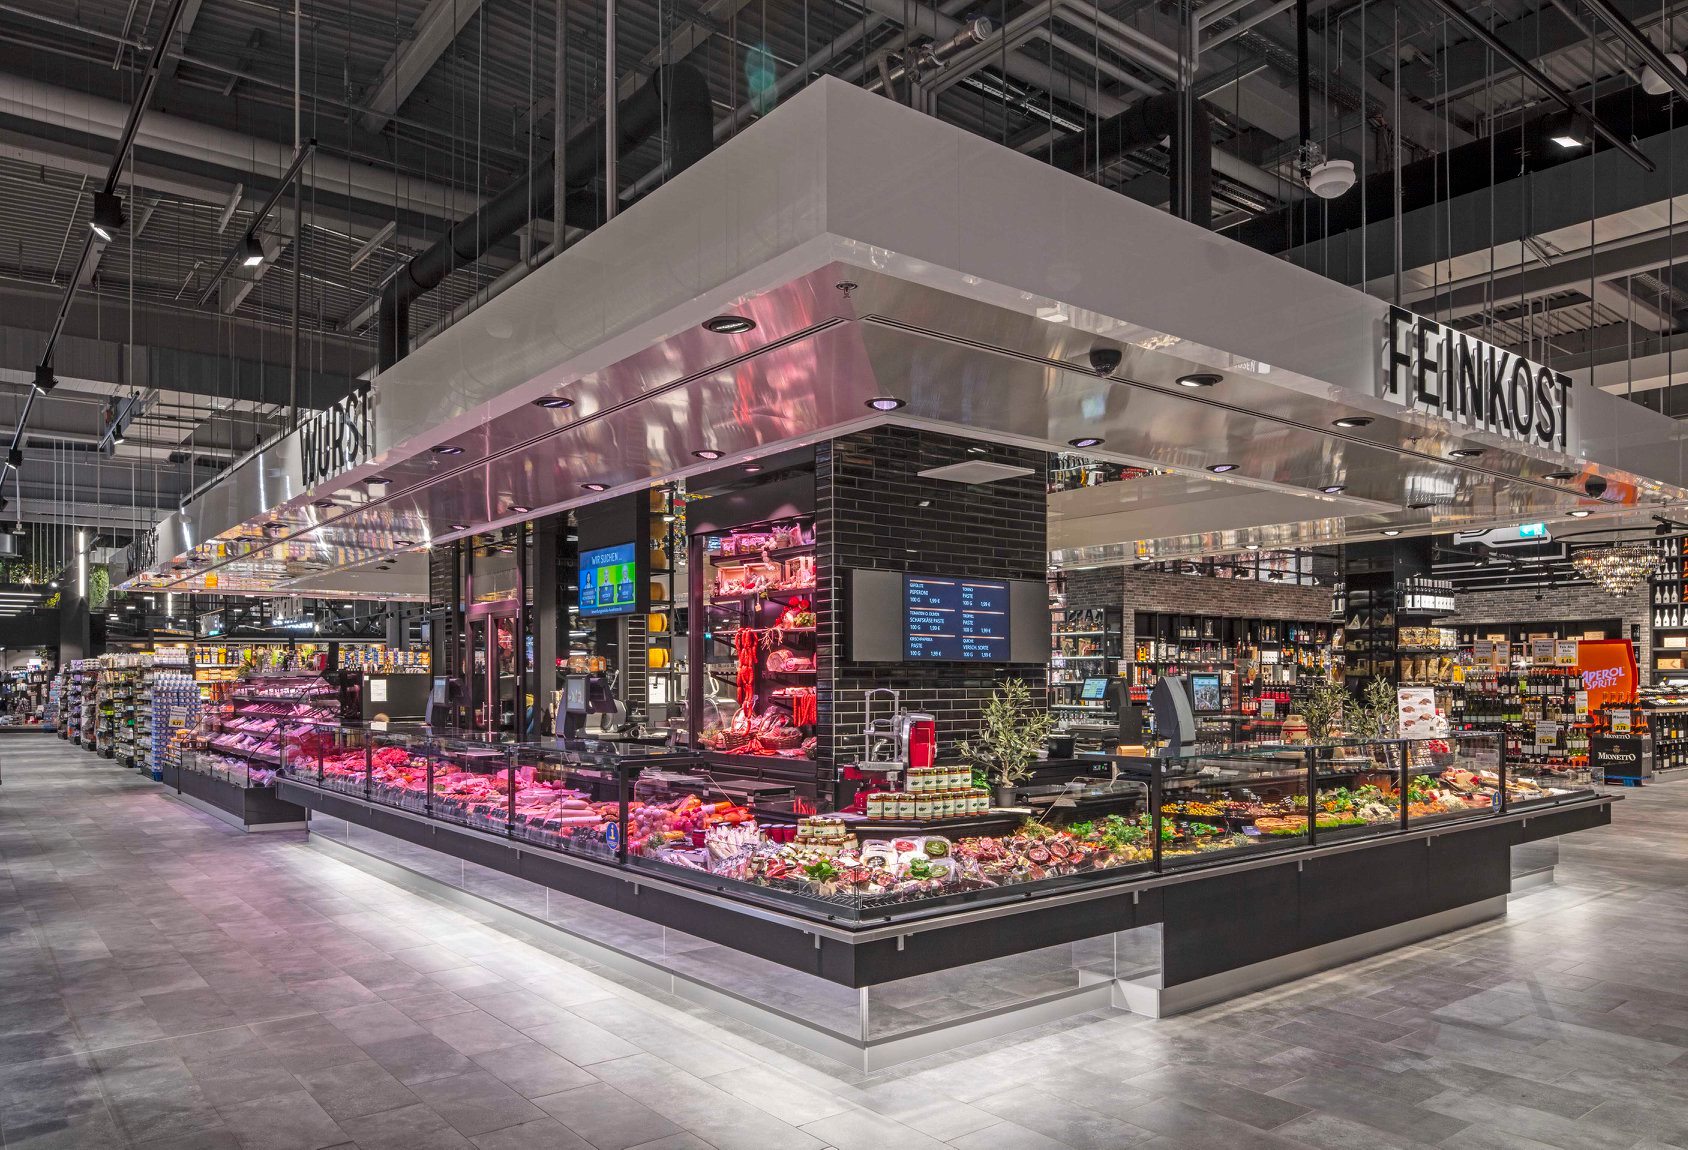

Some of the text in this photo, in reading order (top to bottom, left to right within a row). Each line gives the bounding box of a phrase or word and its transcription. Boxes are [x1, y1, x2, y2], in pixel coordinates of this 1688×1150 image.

[1389, 305, 1573, 447] FEINKOST
[299, 379, 371, 486] WURST
[1582, 666, 1625, 683] APEROL
